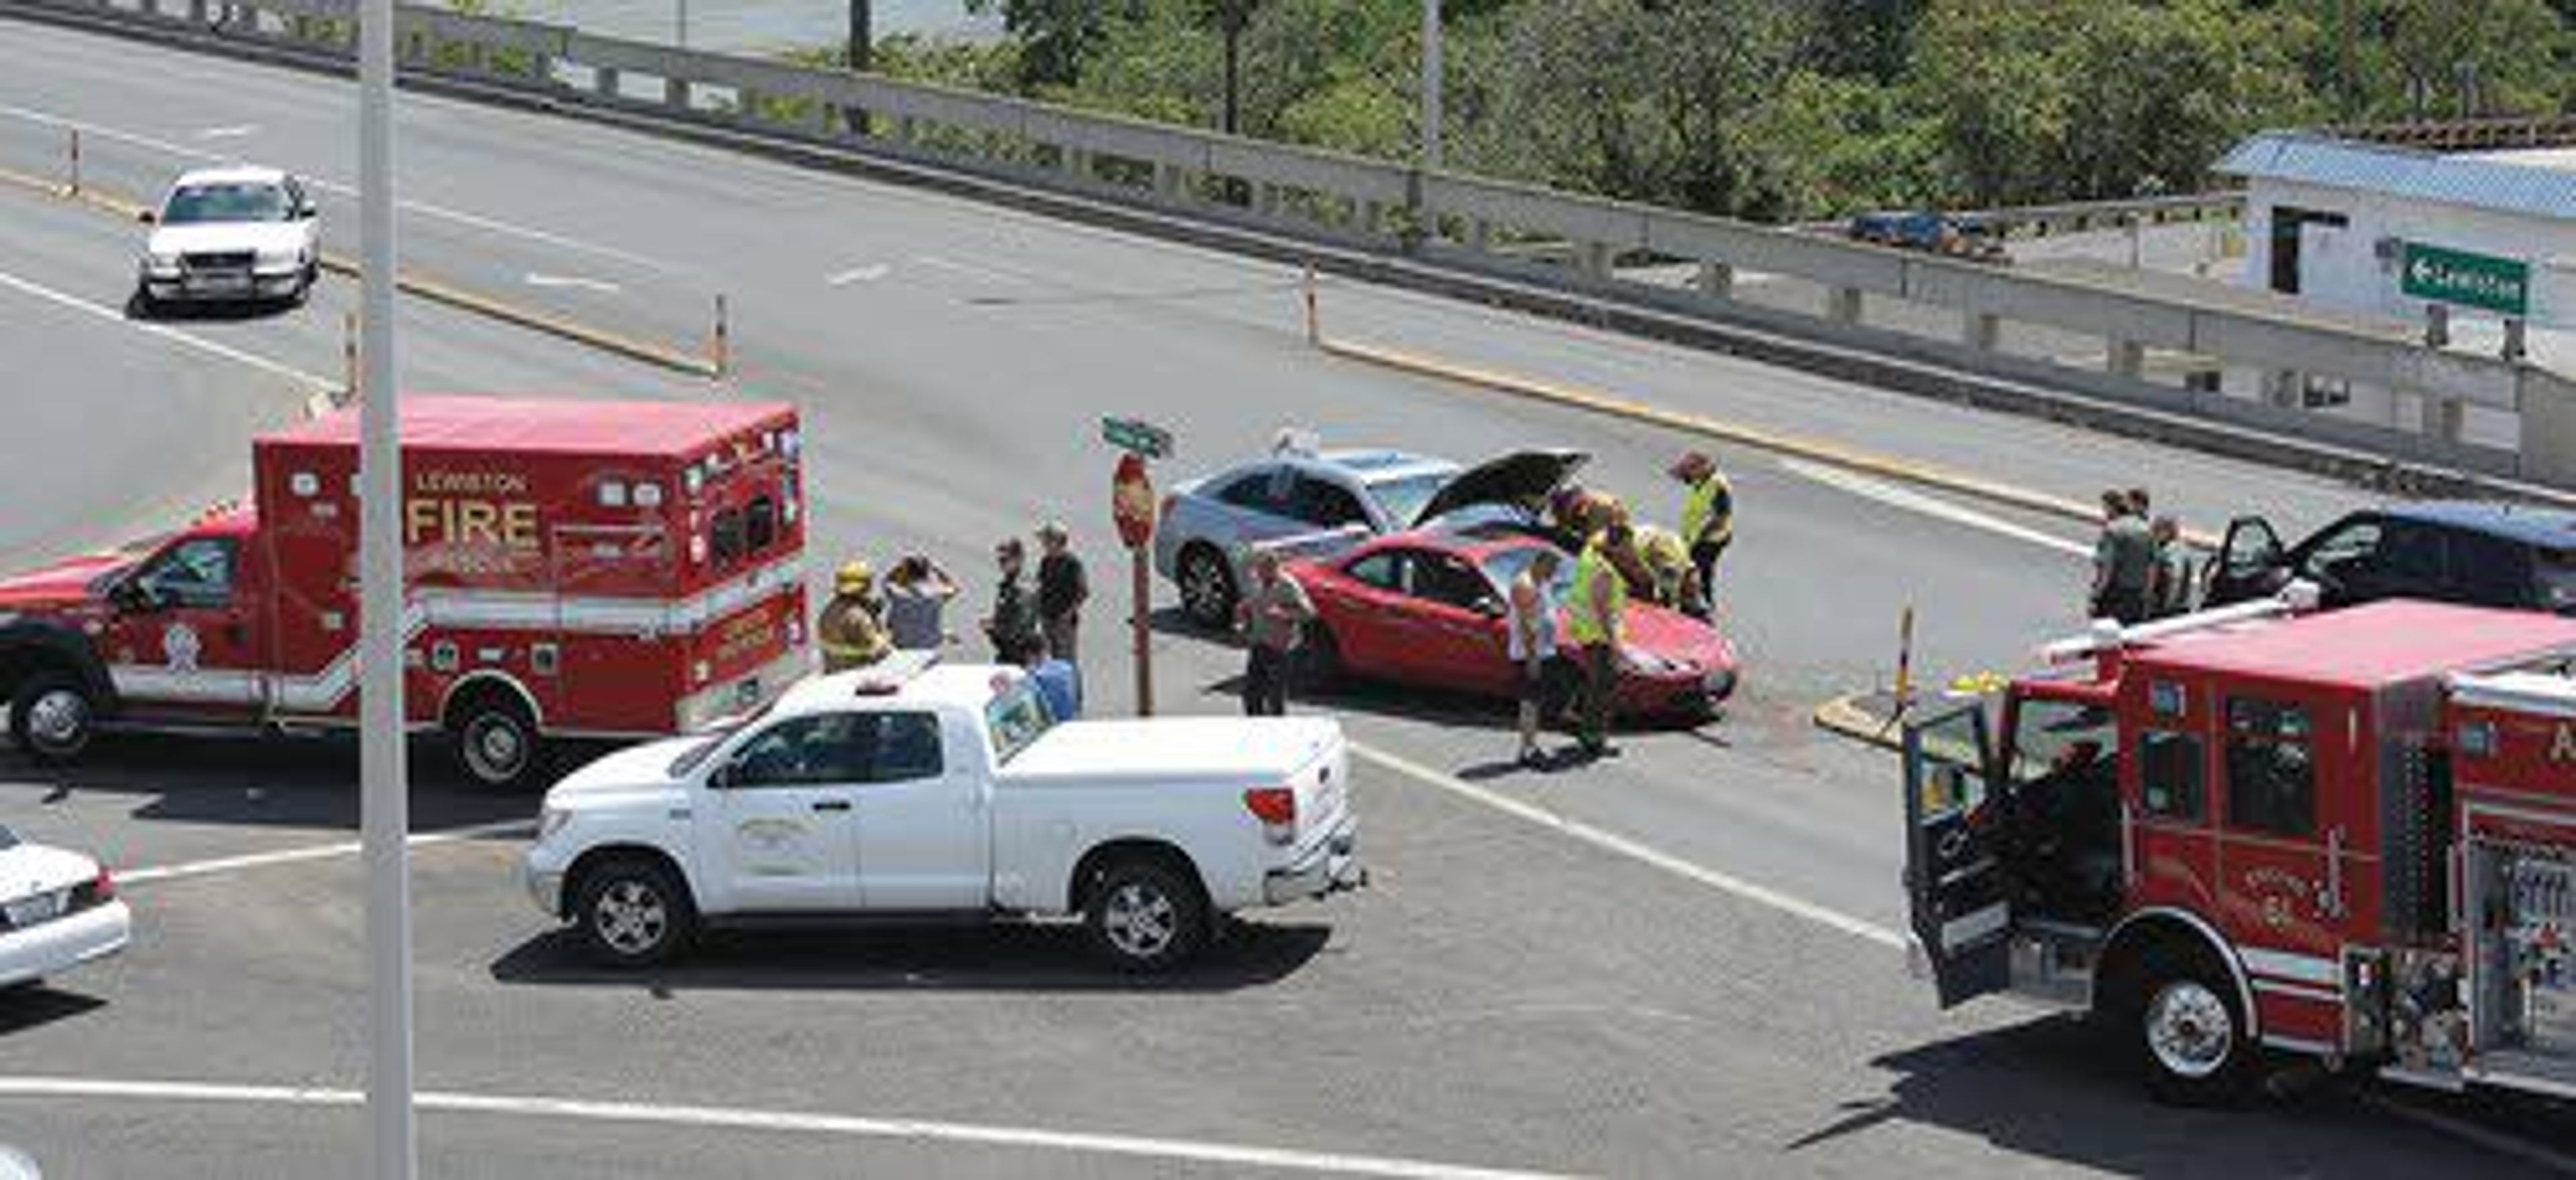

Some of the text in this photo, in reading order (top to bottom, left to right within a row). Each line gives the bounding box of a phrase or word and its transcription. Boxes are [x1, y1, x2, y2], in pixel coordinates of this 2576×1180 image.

[2435, 263, 2520, 299] Lewiston
[416, 473, 527, 492] LEWISTON
[407, 499, 539, 547] FIRE
